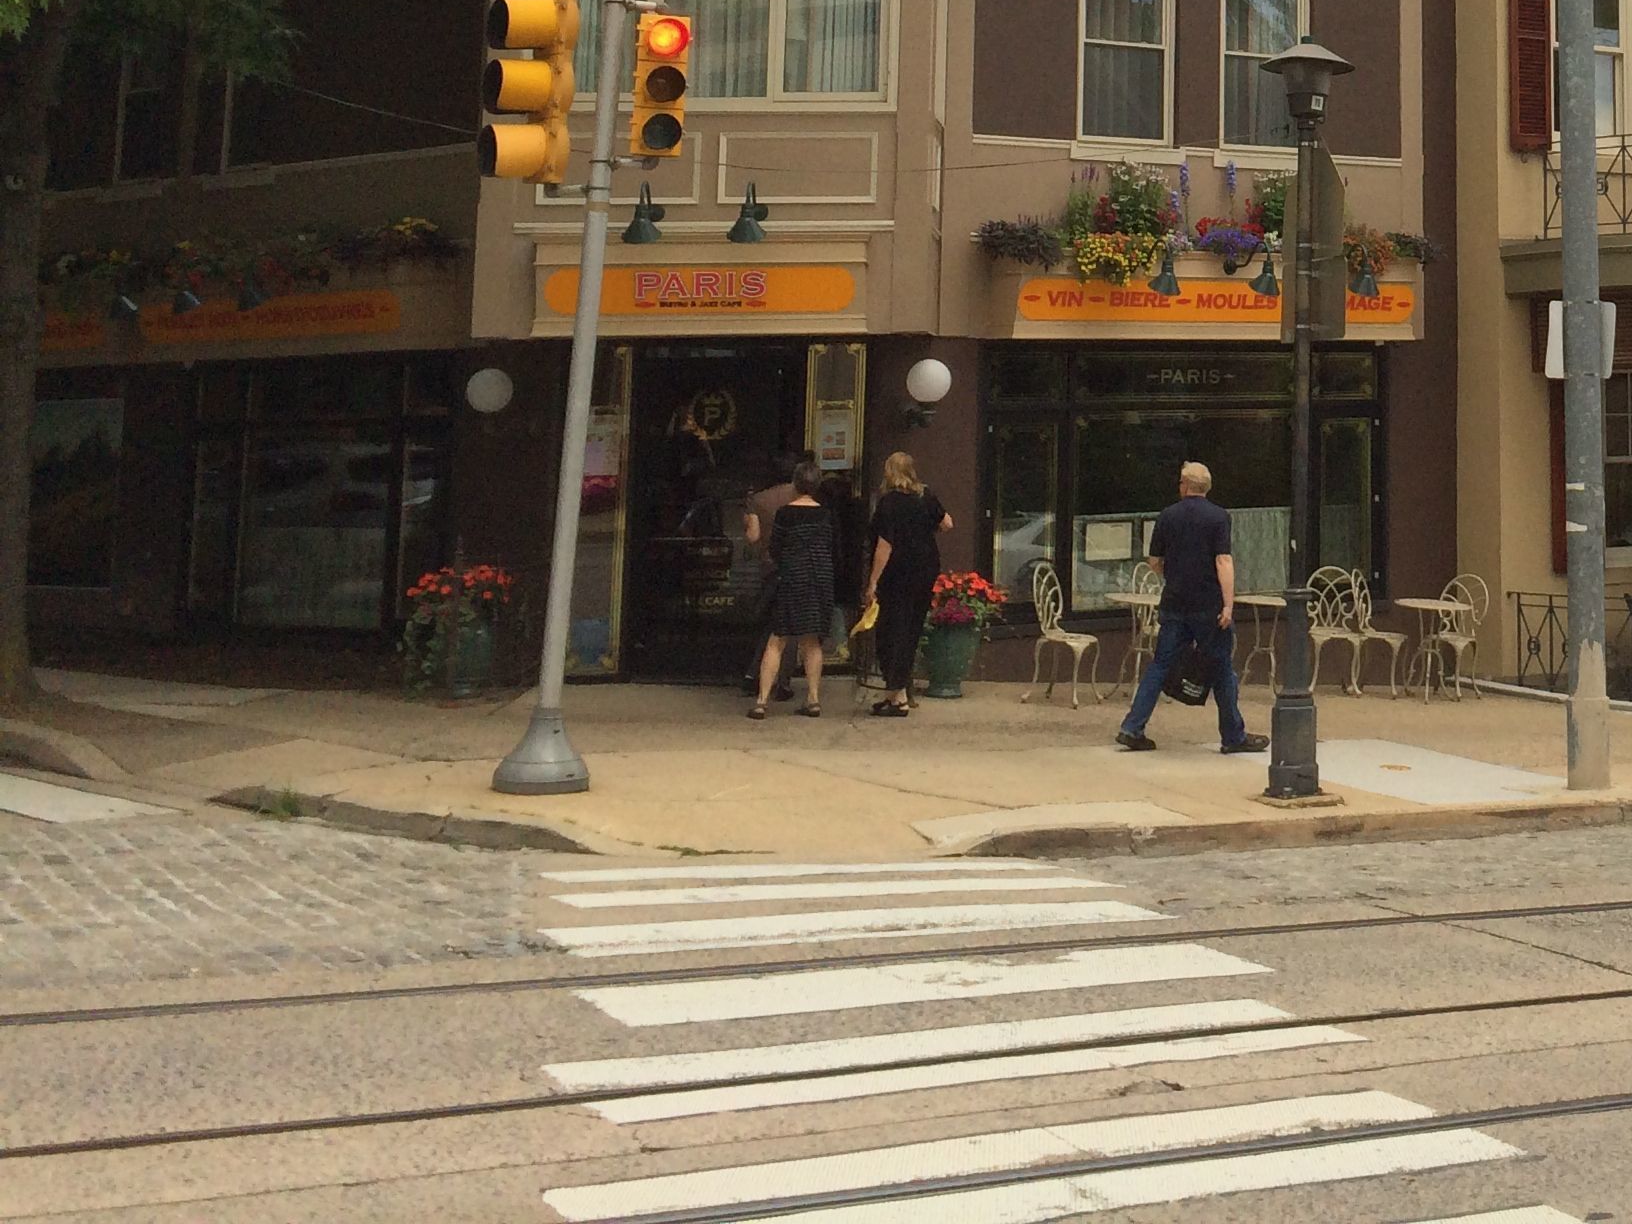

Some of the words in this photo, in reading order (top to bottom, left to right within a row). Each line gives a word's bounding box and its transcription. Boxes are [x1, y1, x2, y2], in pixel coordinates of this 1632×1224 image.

[634, 270, 768, 299] PARIS
[1047, 290, 1084, 308] VIN
[1196, 292, 1278, 310] MOULES
[1160, 368, 1221, 385] PARIS
[703, 406, 722, 426] P
